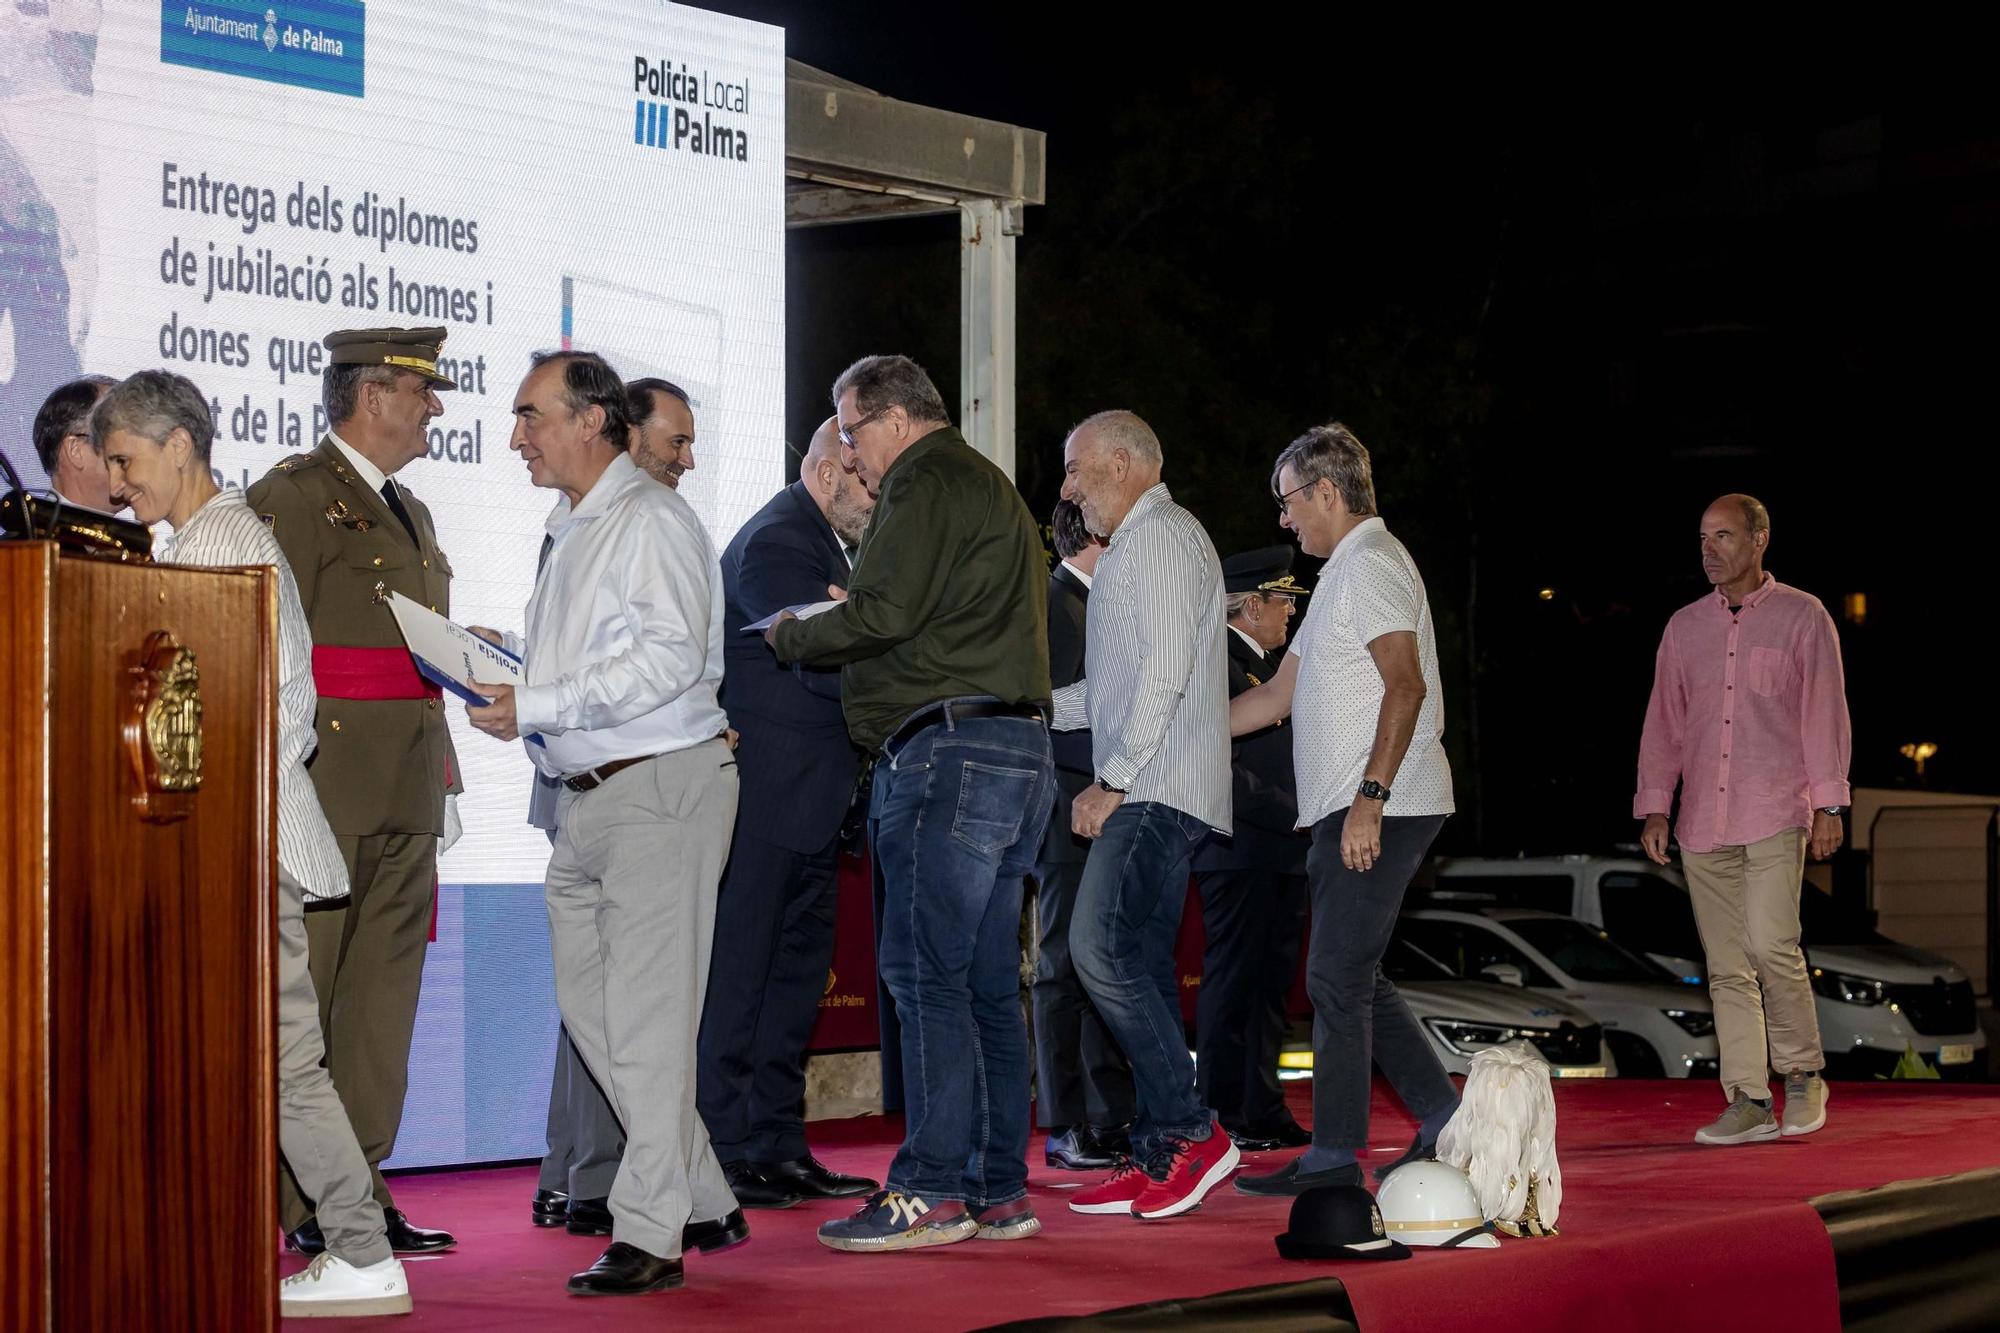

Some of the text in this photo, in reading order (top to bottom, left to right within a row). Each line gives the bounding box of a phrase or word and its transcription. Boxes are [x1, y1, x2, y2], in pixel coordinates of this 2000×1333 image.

[184, 6, 343, 57] Ajuntament de Palma
[635, 56, 748, 114] Policia Local
[674, 107, 747, 162] Palma
[162, 162, 478, 253] Entrega dels diplomes
[160, 236, 493, 325] de jubilació als homes i
[159, 311, 486, 395] dones que mat
[232, 394, 267, 443] de
[278, 398, 301, 446] la
[428, 419, 481, 464] ocal
[445, 623, 476, 649] Local
[478, 643, 518, 676] Policia
